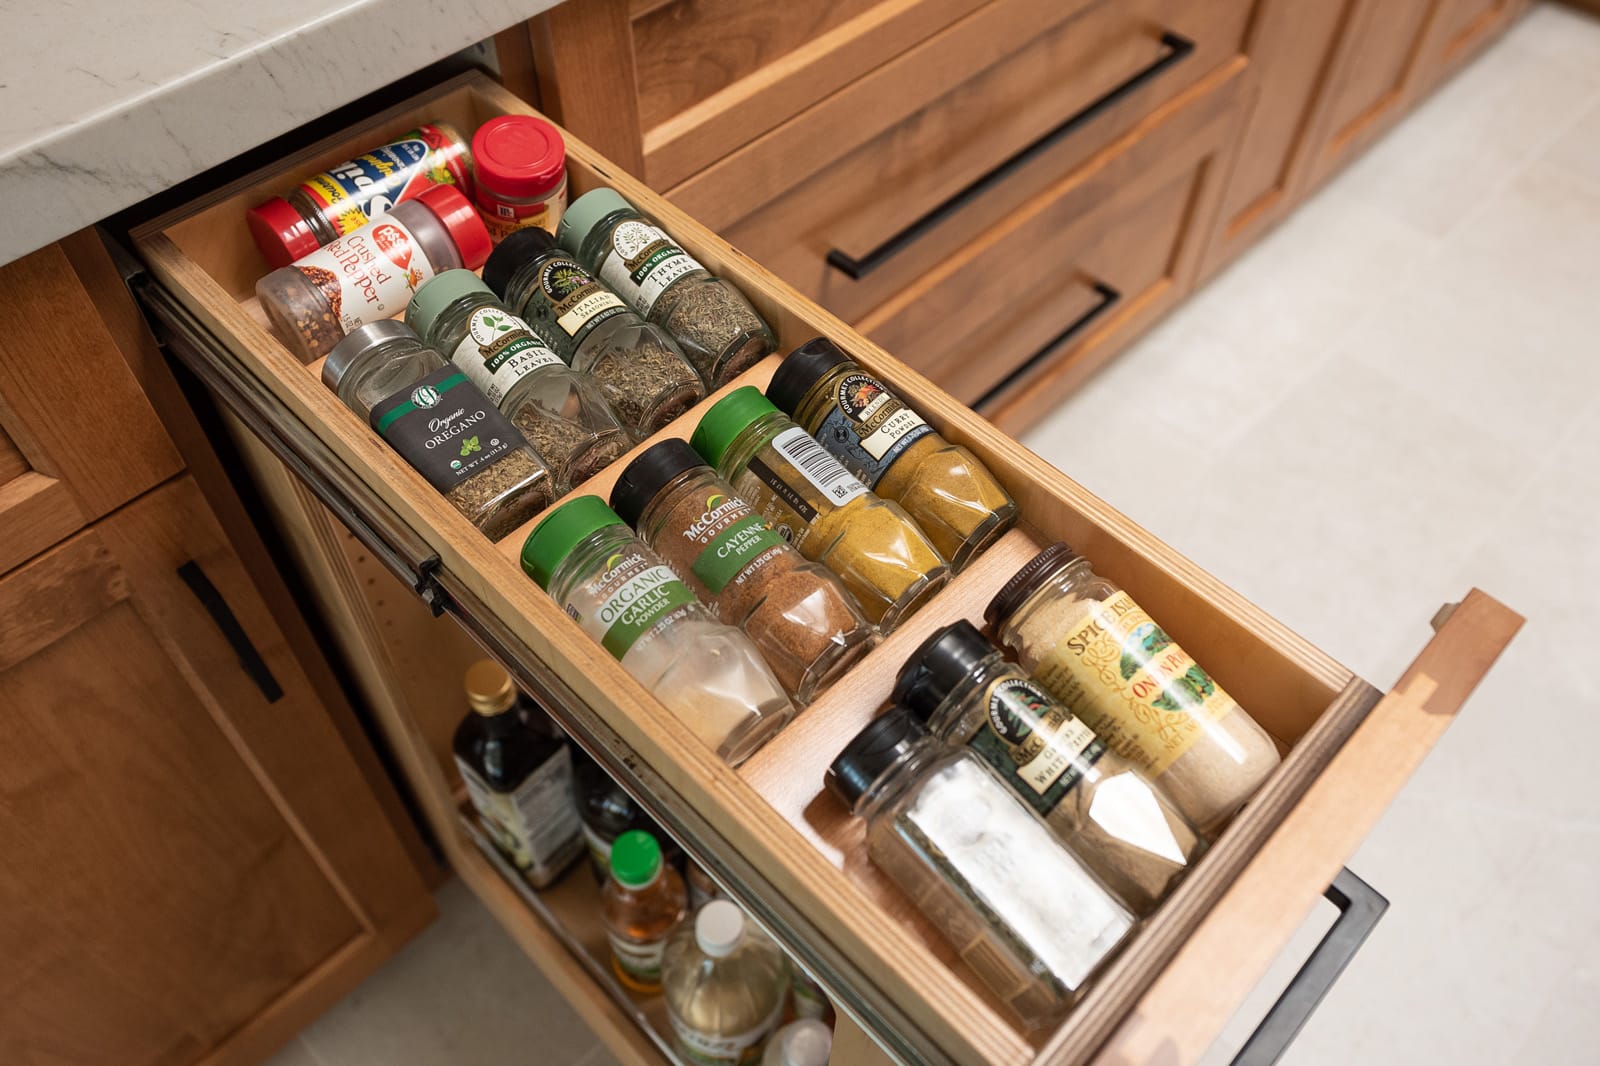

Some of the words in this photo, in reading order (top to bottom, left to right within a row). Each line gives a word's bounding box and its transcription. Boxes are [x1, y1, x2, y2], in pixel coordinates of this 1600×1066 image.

[340, 253, 379, 304] Pepper
[543, 264, 554, 294] GOURMET
[636, 263, 653, 280] 100%
[648, 257, 688, 283] THYME
[490, 351, 510, 368] 100%
[508, 349, 546, 369] BASIL
[839, 382, 853, 414] GOURMET
[424, 410, 486, 449] OREGANO
[428, 407, 465, 433] Organic
[881, 412, 911, 434] CURRY
[683, 496, 748, 541] McCormick
[701, 507, 750, 544] GOURMET
[717, 522, 765, 558] CAYENNE
[735, 535, 762, 555] PEPPER
[586, 553, 646, 595] McCormick
[600, 568, 670, 623] ORGANIC
[621, 585, 670, 625] GARLIC
[634, 598, 670, 627] POWDER
[1132, 661, 1174, 698] ONIN
[990, 687, 1008, 735] GOURME
[1034, 755, 1066, 784] WHIT
